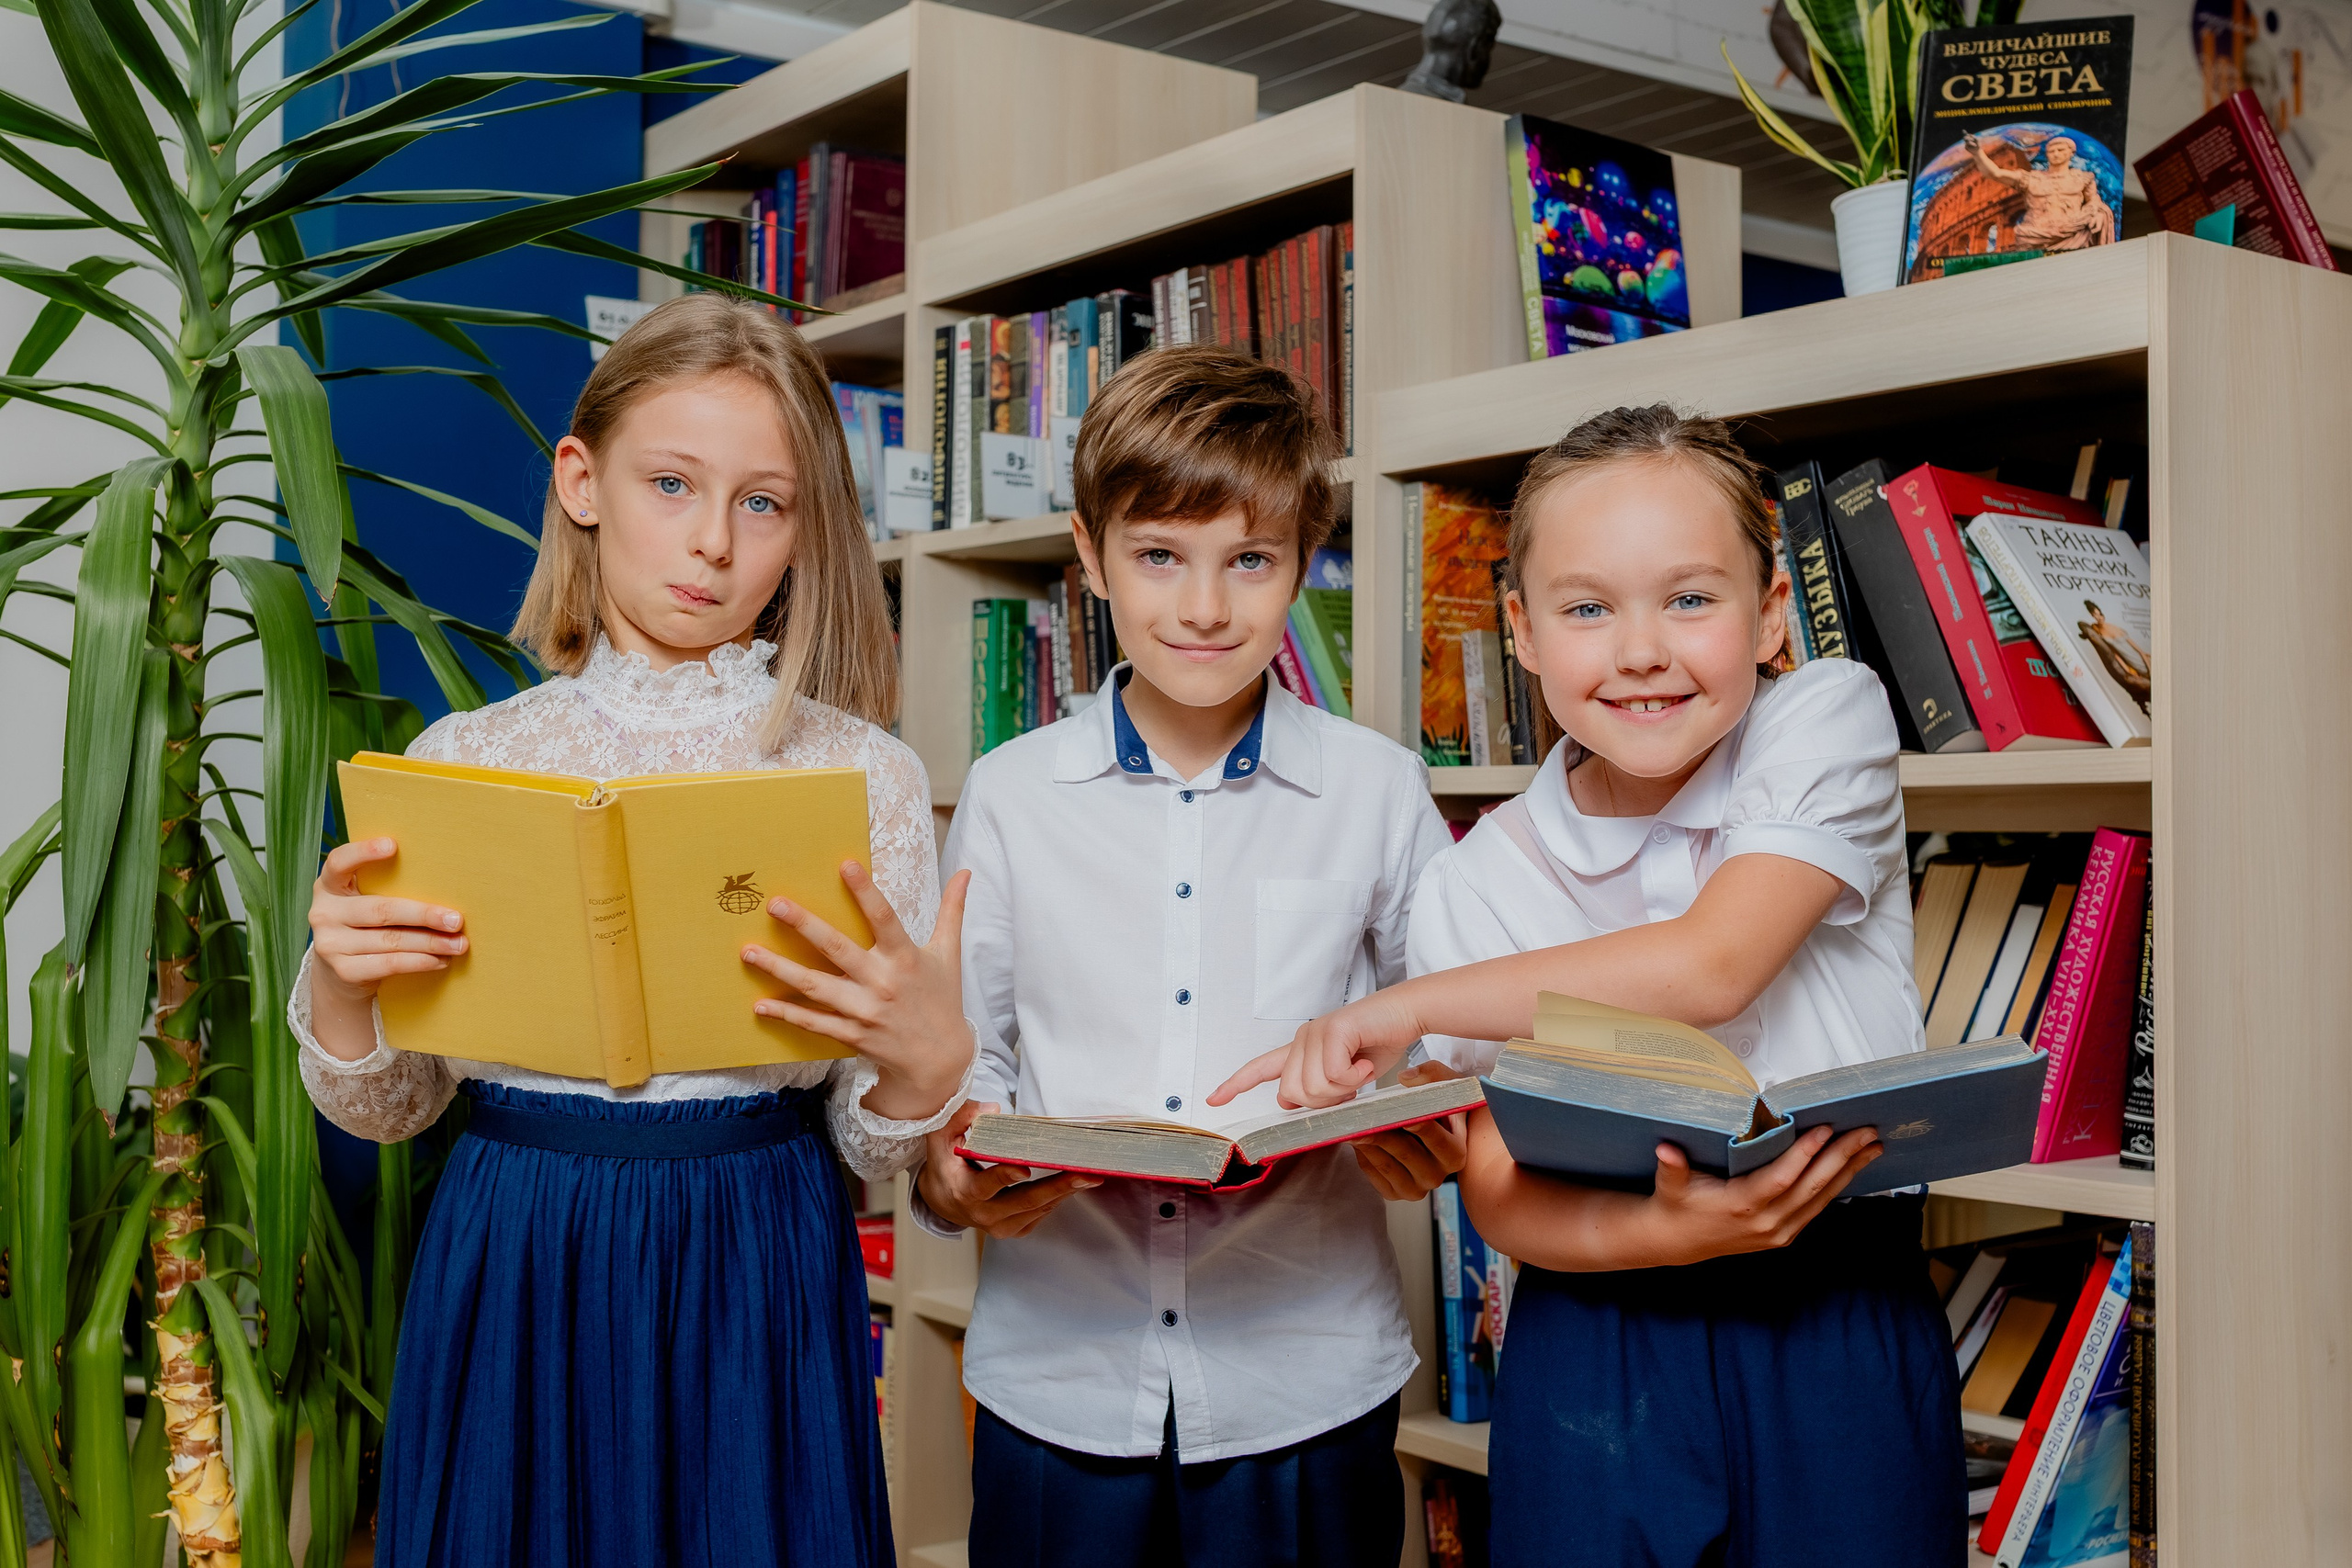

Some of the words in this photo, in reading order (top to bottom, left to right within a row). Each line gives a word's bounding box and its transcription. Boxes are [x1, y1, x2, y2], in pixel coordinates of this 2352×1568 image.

[1944, 30, 2111, 57] ВЕЛИЧАЙШИЕ
[1980, 51, 2069, 71] ЧУДЕСА
[1934, 102, 2044, 118] ЭНЦИКЛОПЕДИЧЕСКИЙ
[2047, 97, 2112, 111] СПРАВОЧНИК
[1941, 64, 2104, 103] СВЕТА
[1526, 297, 1542, 353] СВЕТА
[934, 358, 947, 502] МИФОЛОГИЯ
[1976, 527, 2020, 584] ПОРТРЕТОВ
[2018, 524, 2120, 557] ТАЙНЫ
[2037, 552, 2136, 579] ЖЕНСКИХ
[2014, 581, 2052, 632] ЖЕНСКИХ
[2046, 628, 2075, 668] ТАЙНЫ
[2065, 844, 2103, 952] КЕРАМИКА
[2083, 849, 2117, 930] РУССКАЯ
[593, 909, 627, 922] ЭФРАИМ
[594, 925, 629, 939] ЛЕССИНГ
[2040, 933, 2095, 1103] ХУДОЖЕСТВЕННАЯ
[2078, 1301, 2117, 1376] ЦВЕТОВОЕ
[2132, 1334, 2143, 1382] УСАДЬБЫ
[2038, 1375, 2086, 1478] ОФОРМЛЕНИЕ
[2132, 1385, 2141, 1459] РОССИЙСКОЙ
[2011, 1477, 2045, 1542] ИНТЕРЬЕРА
[2132, 1484, 2140, 1525] НОВЫЙ
